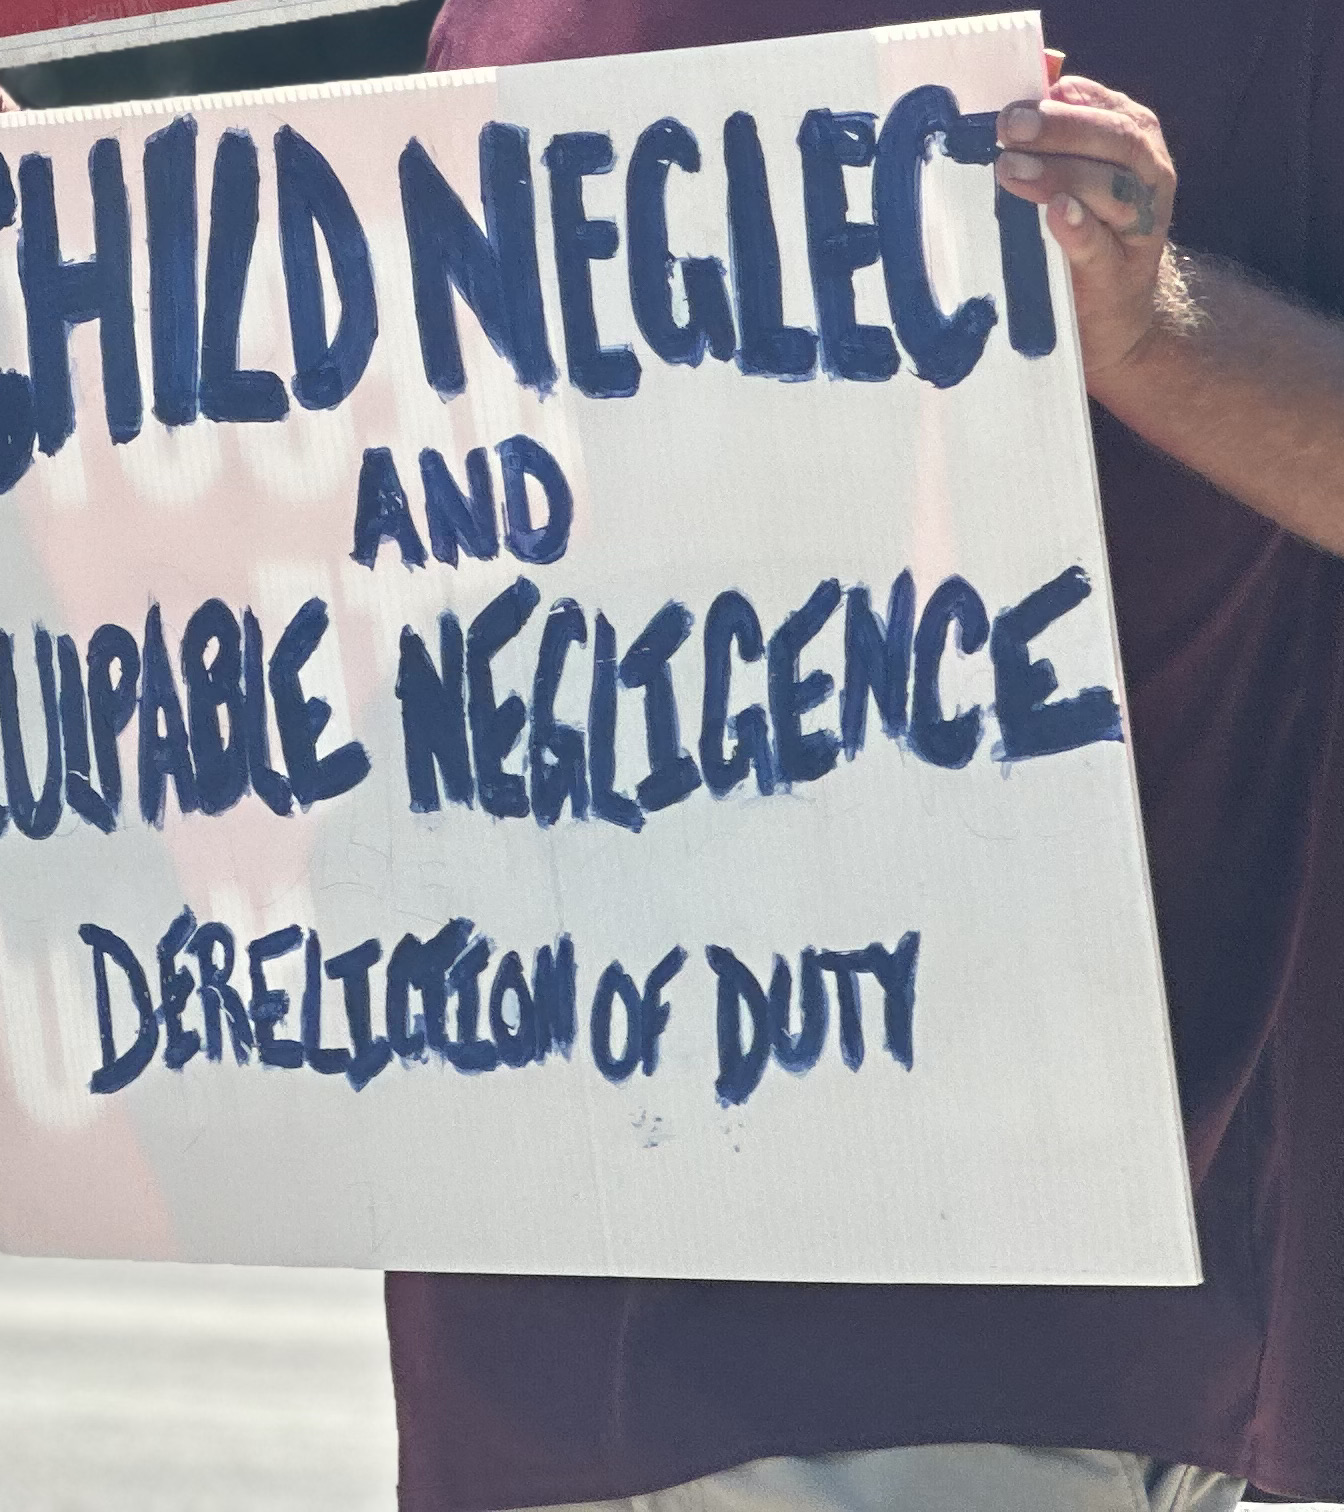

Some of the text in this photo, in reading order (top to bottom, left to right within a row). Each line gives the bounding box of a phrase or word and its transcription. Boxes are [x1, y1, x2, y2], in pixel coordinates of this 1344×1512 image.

[350, 434, 573, 570] AND
[396, 567, 1124, 833] NEGLIGENCE
[78, 905, 921, 1109] DERELICTION OF DUTY
